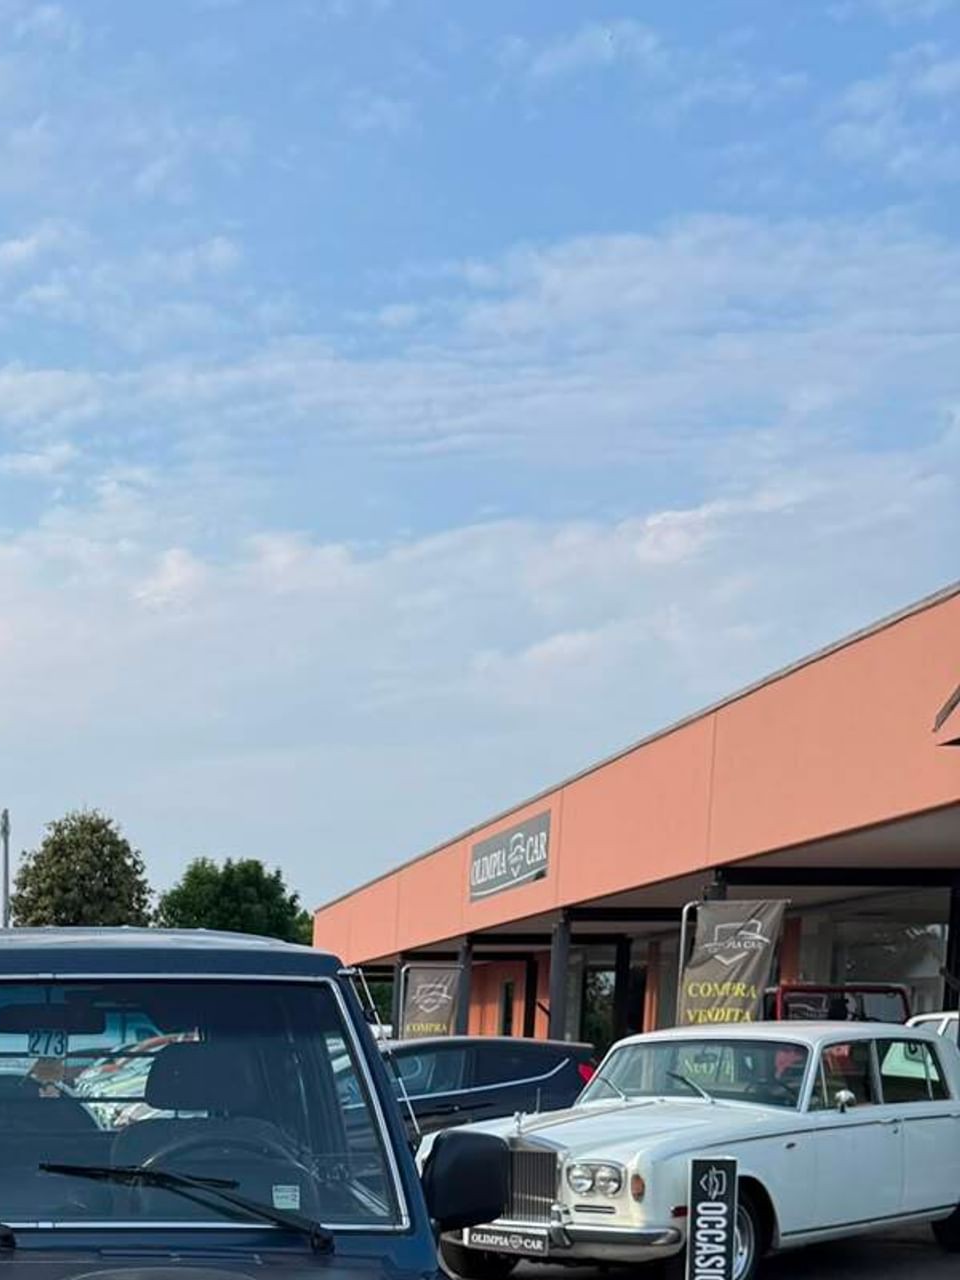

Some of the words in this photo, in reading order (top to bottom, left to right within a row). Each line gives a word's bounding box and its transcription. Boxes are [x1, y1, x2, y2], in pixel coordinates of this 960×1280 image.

[471, 848, 506, 886] OLIMPIA
[526, 832, 547, 865] CAR
[687, 982, 757, 999] COMPRA
[686, 1008, 753, 1024] VENDITA
[30, 1029, 64, 1055] 273
[471, 1233, 509, 1247] OLIMPIA
